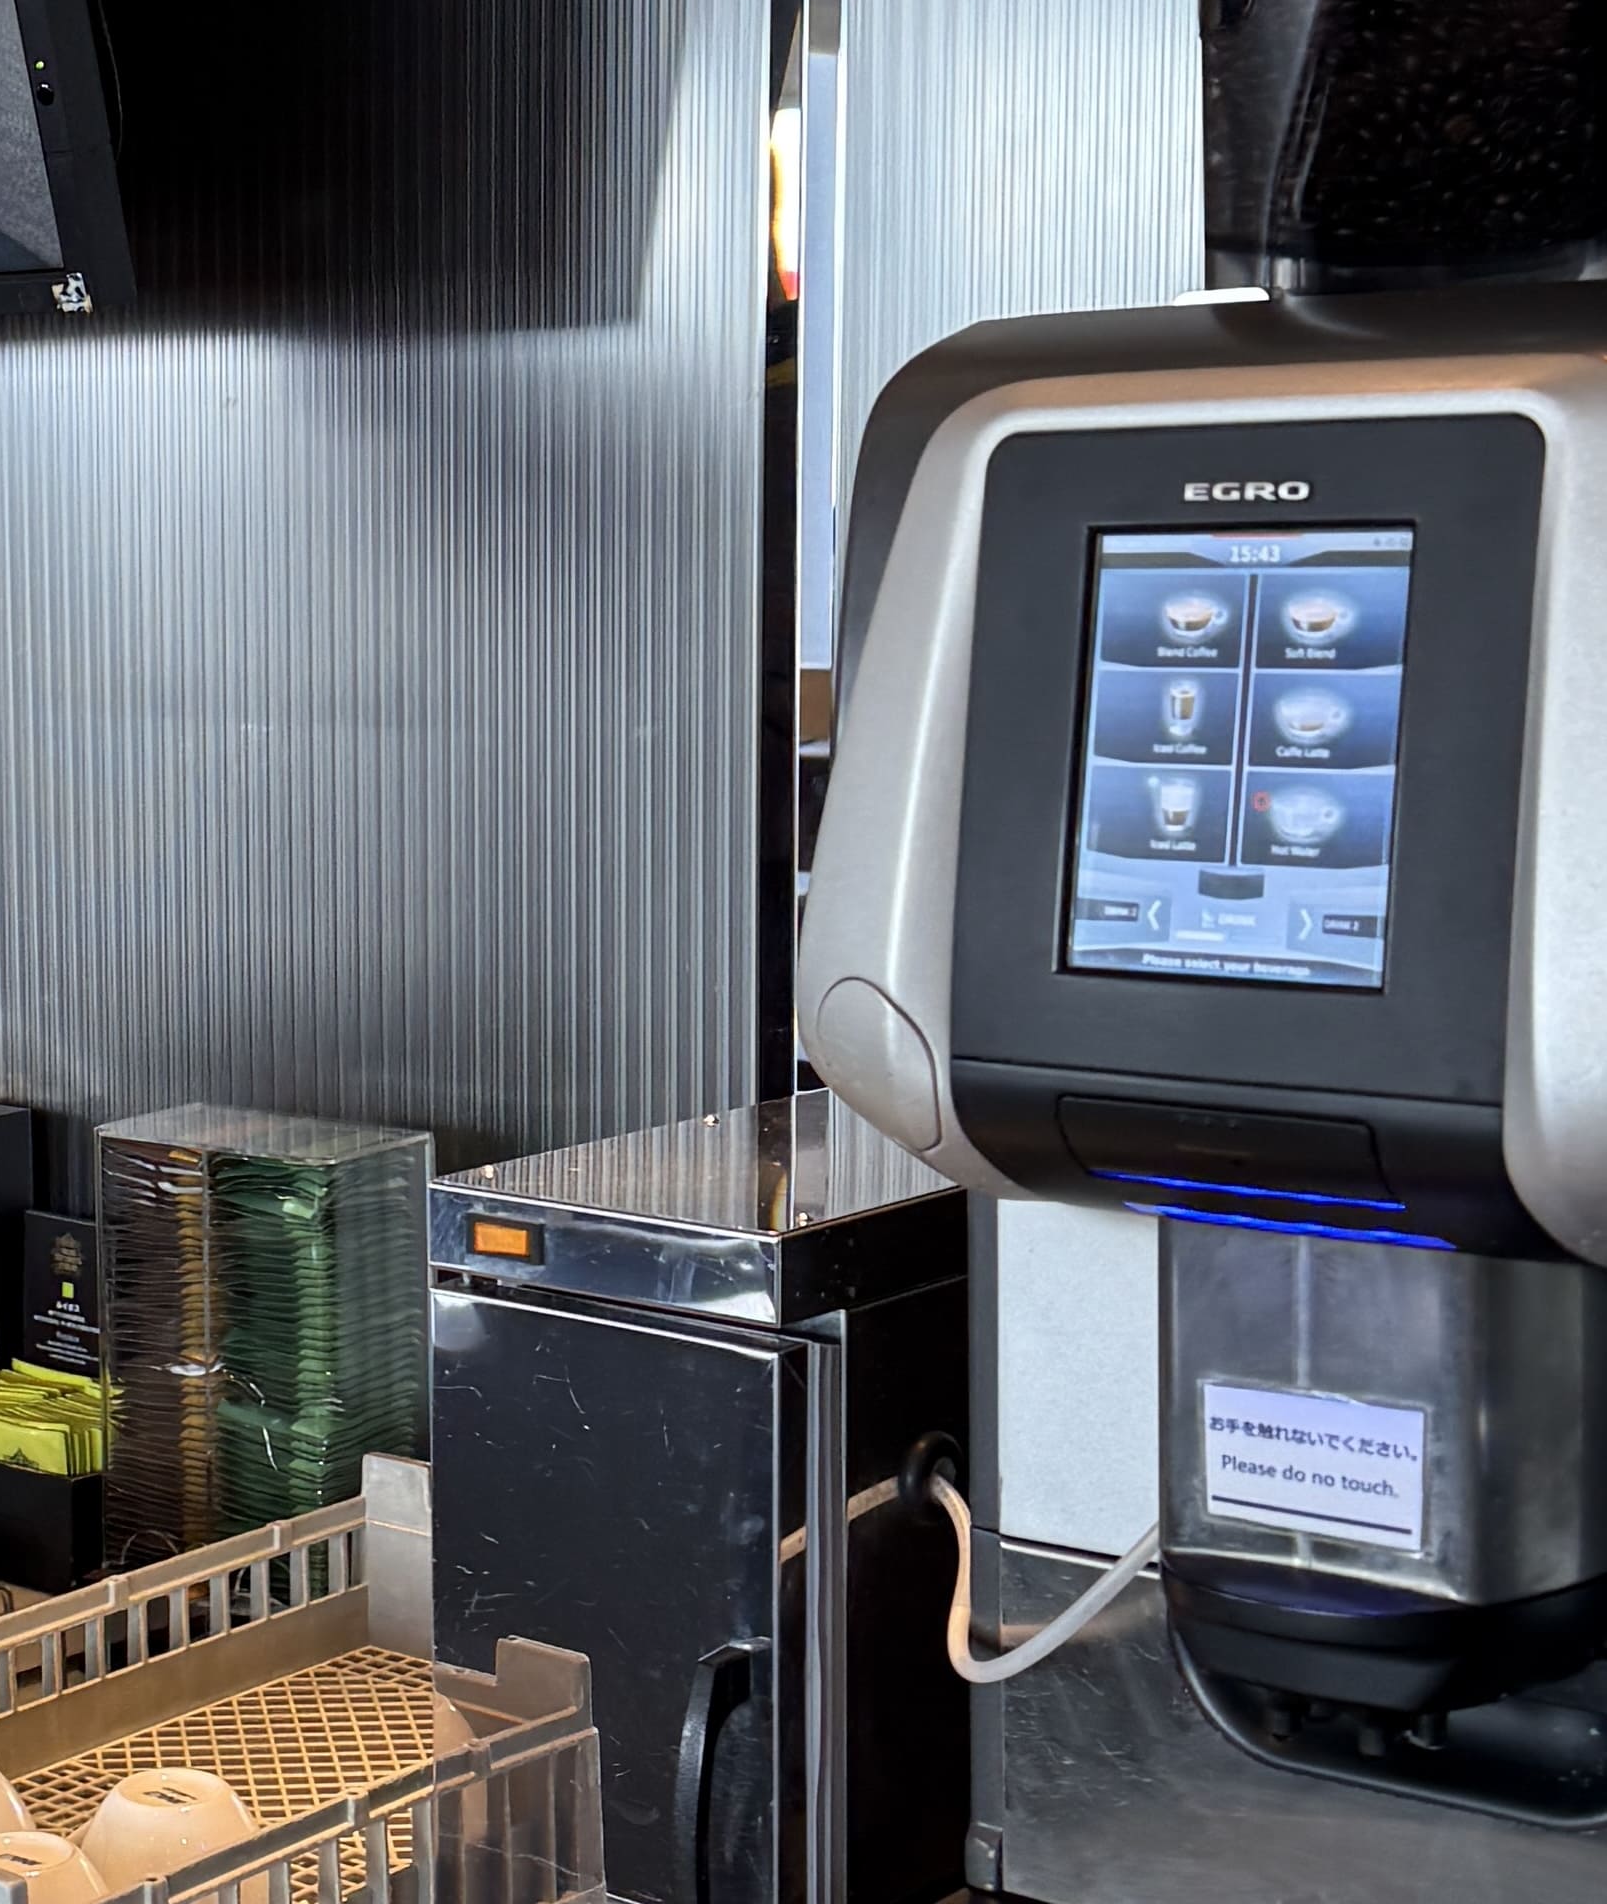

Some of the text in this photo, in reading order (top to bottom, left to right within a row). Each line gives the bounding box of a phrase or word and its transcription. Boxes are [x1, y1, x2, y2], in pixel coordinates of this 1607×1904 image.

[1184, 480, 1310, 502] EGRO
[1229, 545, 1281, 563] 15:43
[1142, 953, 1182, 967] Please
[1185, 957, 1220, 971] select
[1209, 1416, 1418, 1463] お手を触れないでください。
[1221, 1453, 1400, 1498] Please do no touch.
